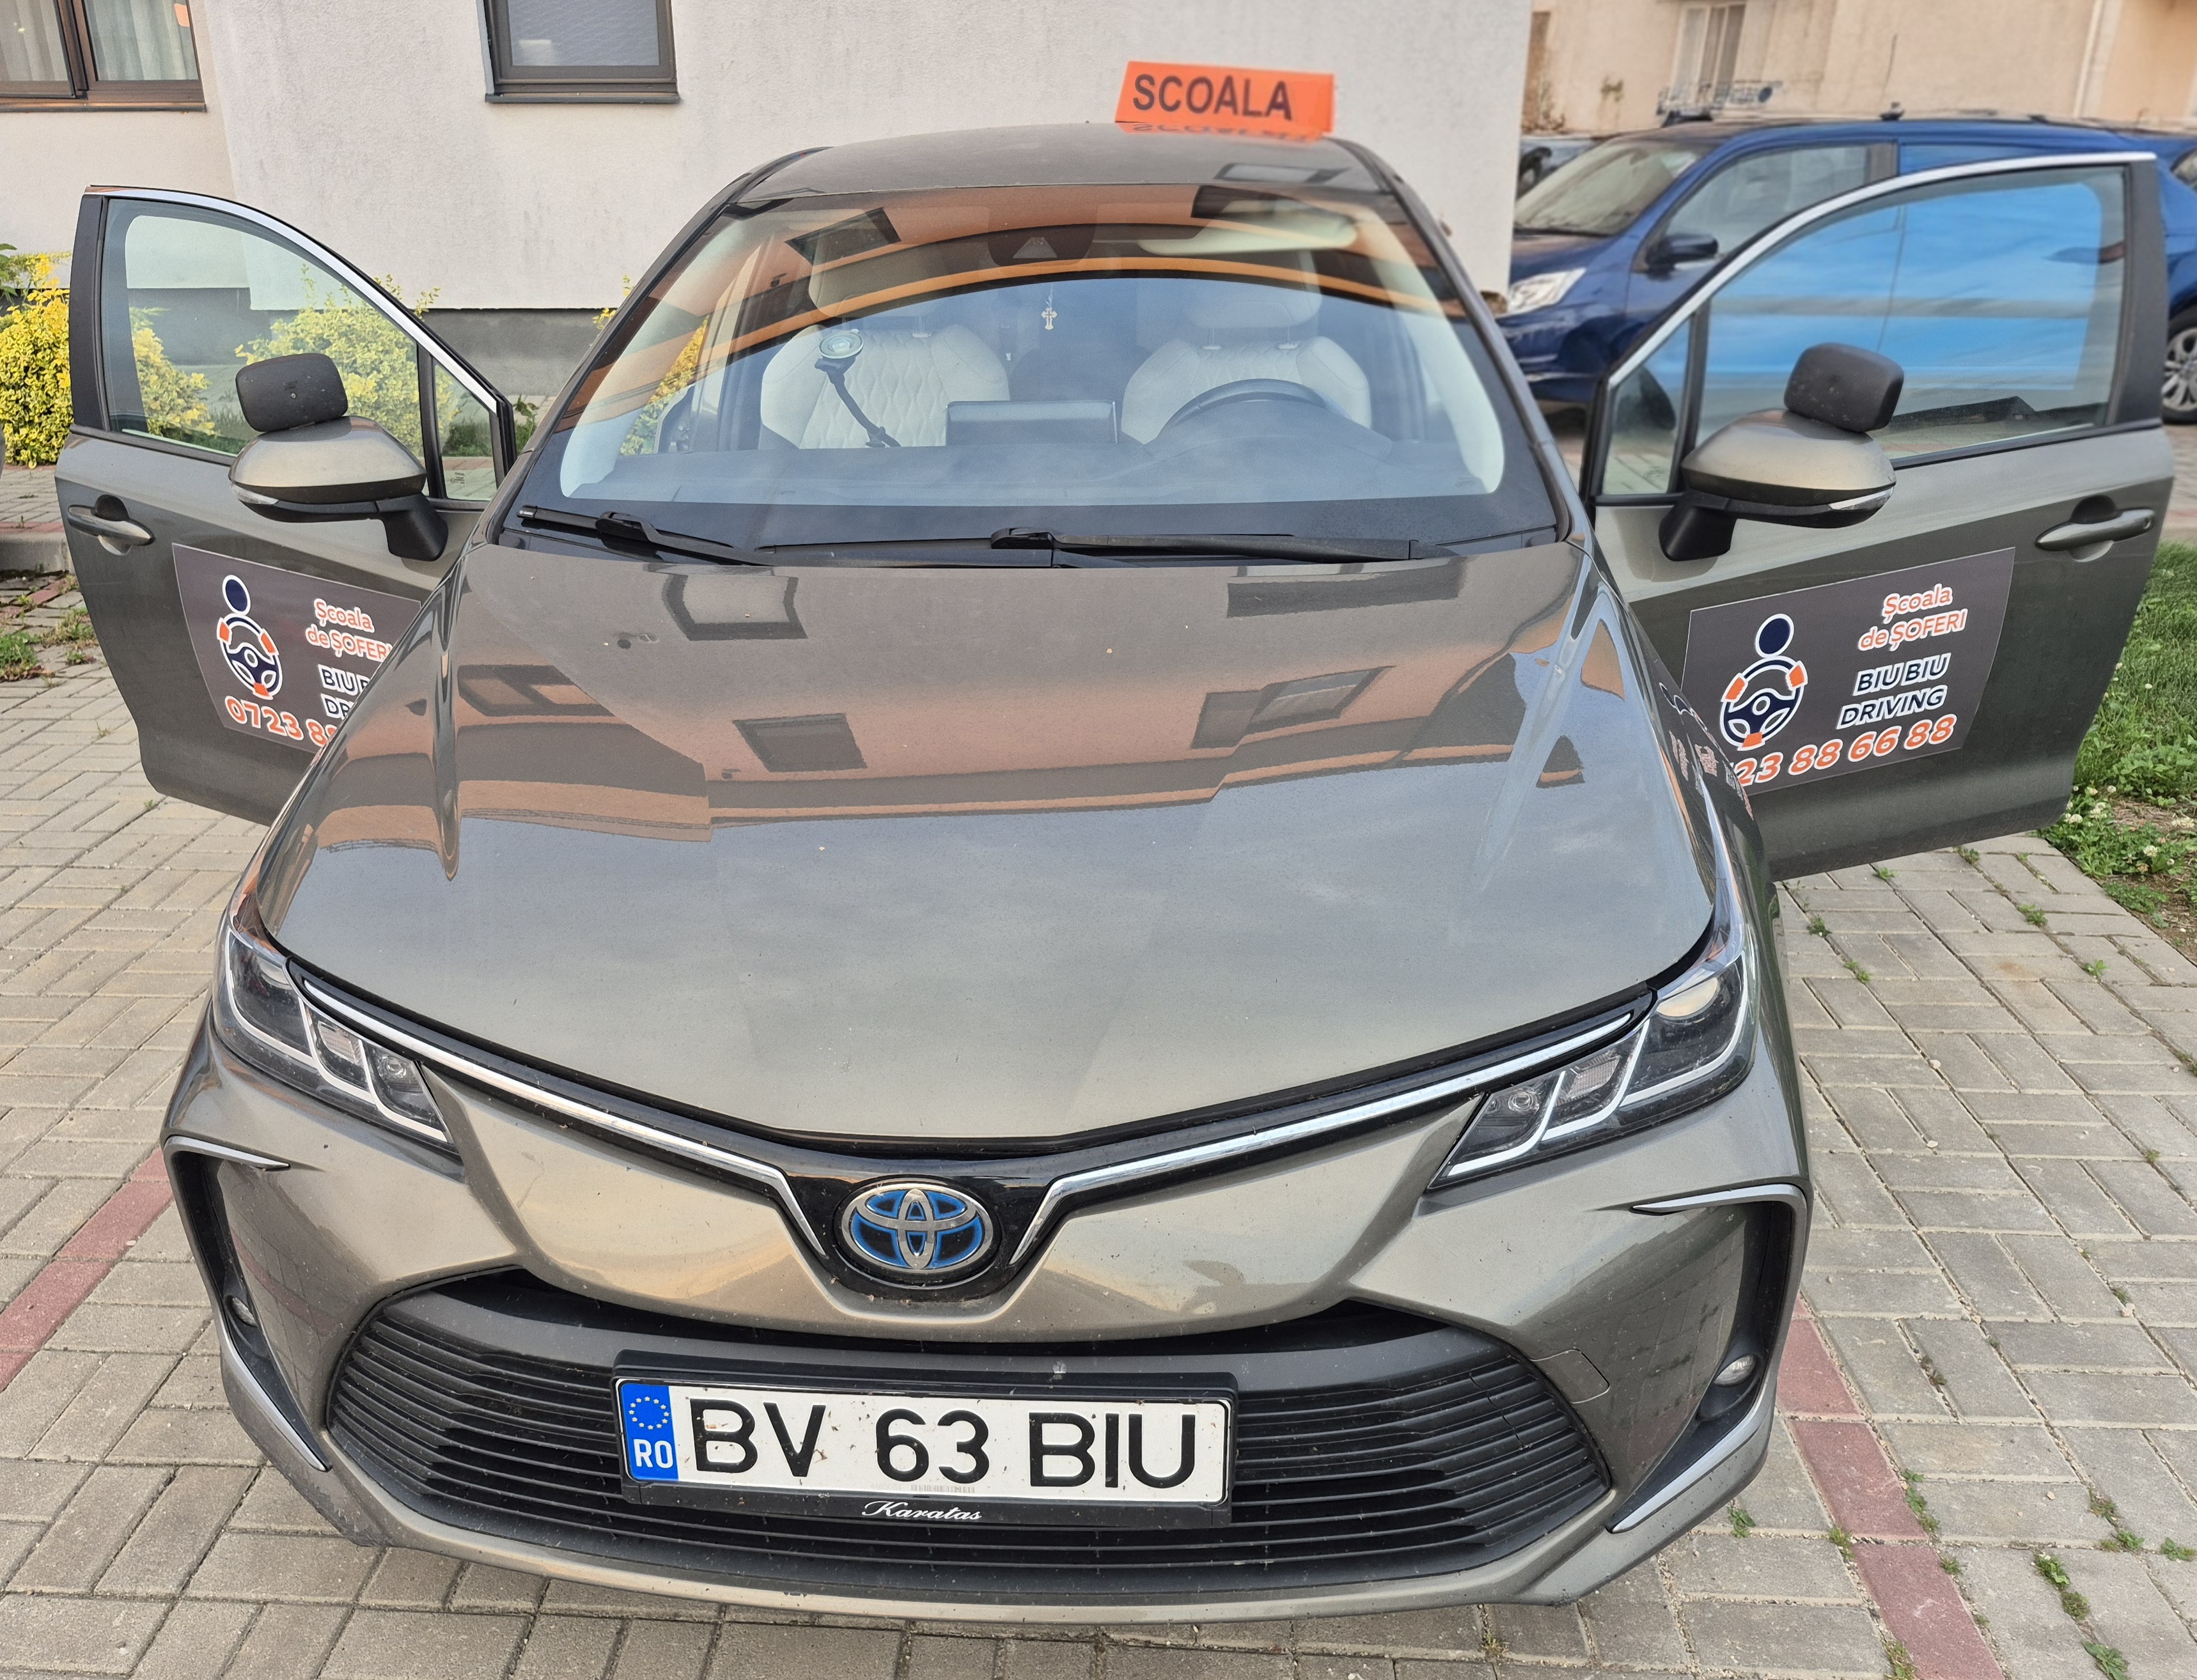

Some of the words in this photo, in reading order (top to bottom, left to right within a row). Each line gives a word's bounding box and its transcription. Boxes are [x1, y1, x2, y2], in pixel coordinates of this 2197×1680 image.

[1132, 74, 1292, 121] SCOALA
[307, 625, 329, 648] de
[330, 630, 393, 661] ȘOFER
[1859, 626, 1888, 650] de
[225, 696, 304, 740] 0723
[1838, 686, 1946, 728] DRIVING
[1733, 752, 1783, 786] 23
[1789, 739, 1843, 775] 88
[1849, 726, 1902, 761] 66
[1904, 714, 1957, 749] 88
[633, 1438, 673, 1468] RO
[689, 1398, 827, 1477] BV
[875, 1408, 989, 1483] 63
[1029, 1412, 1196, 1489] BIU
[861, 1500, 982, 1520] Karatas
